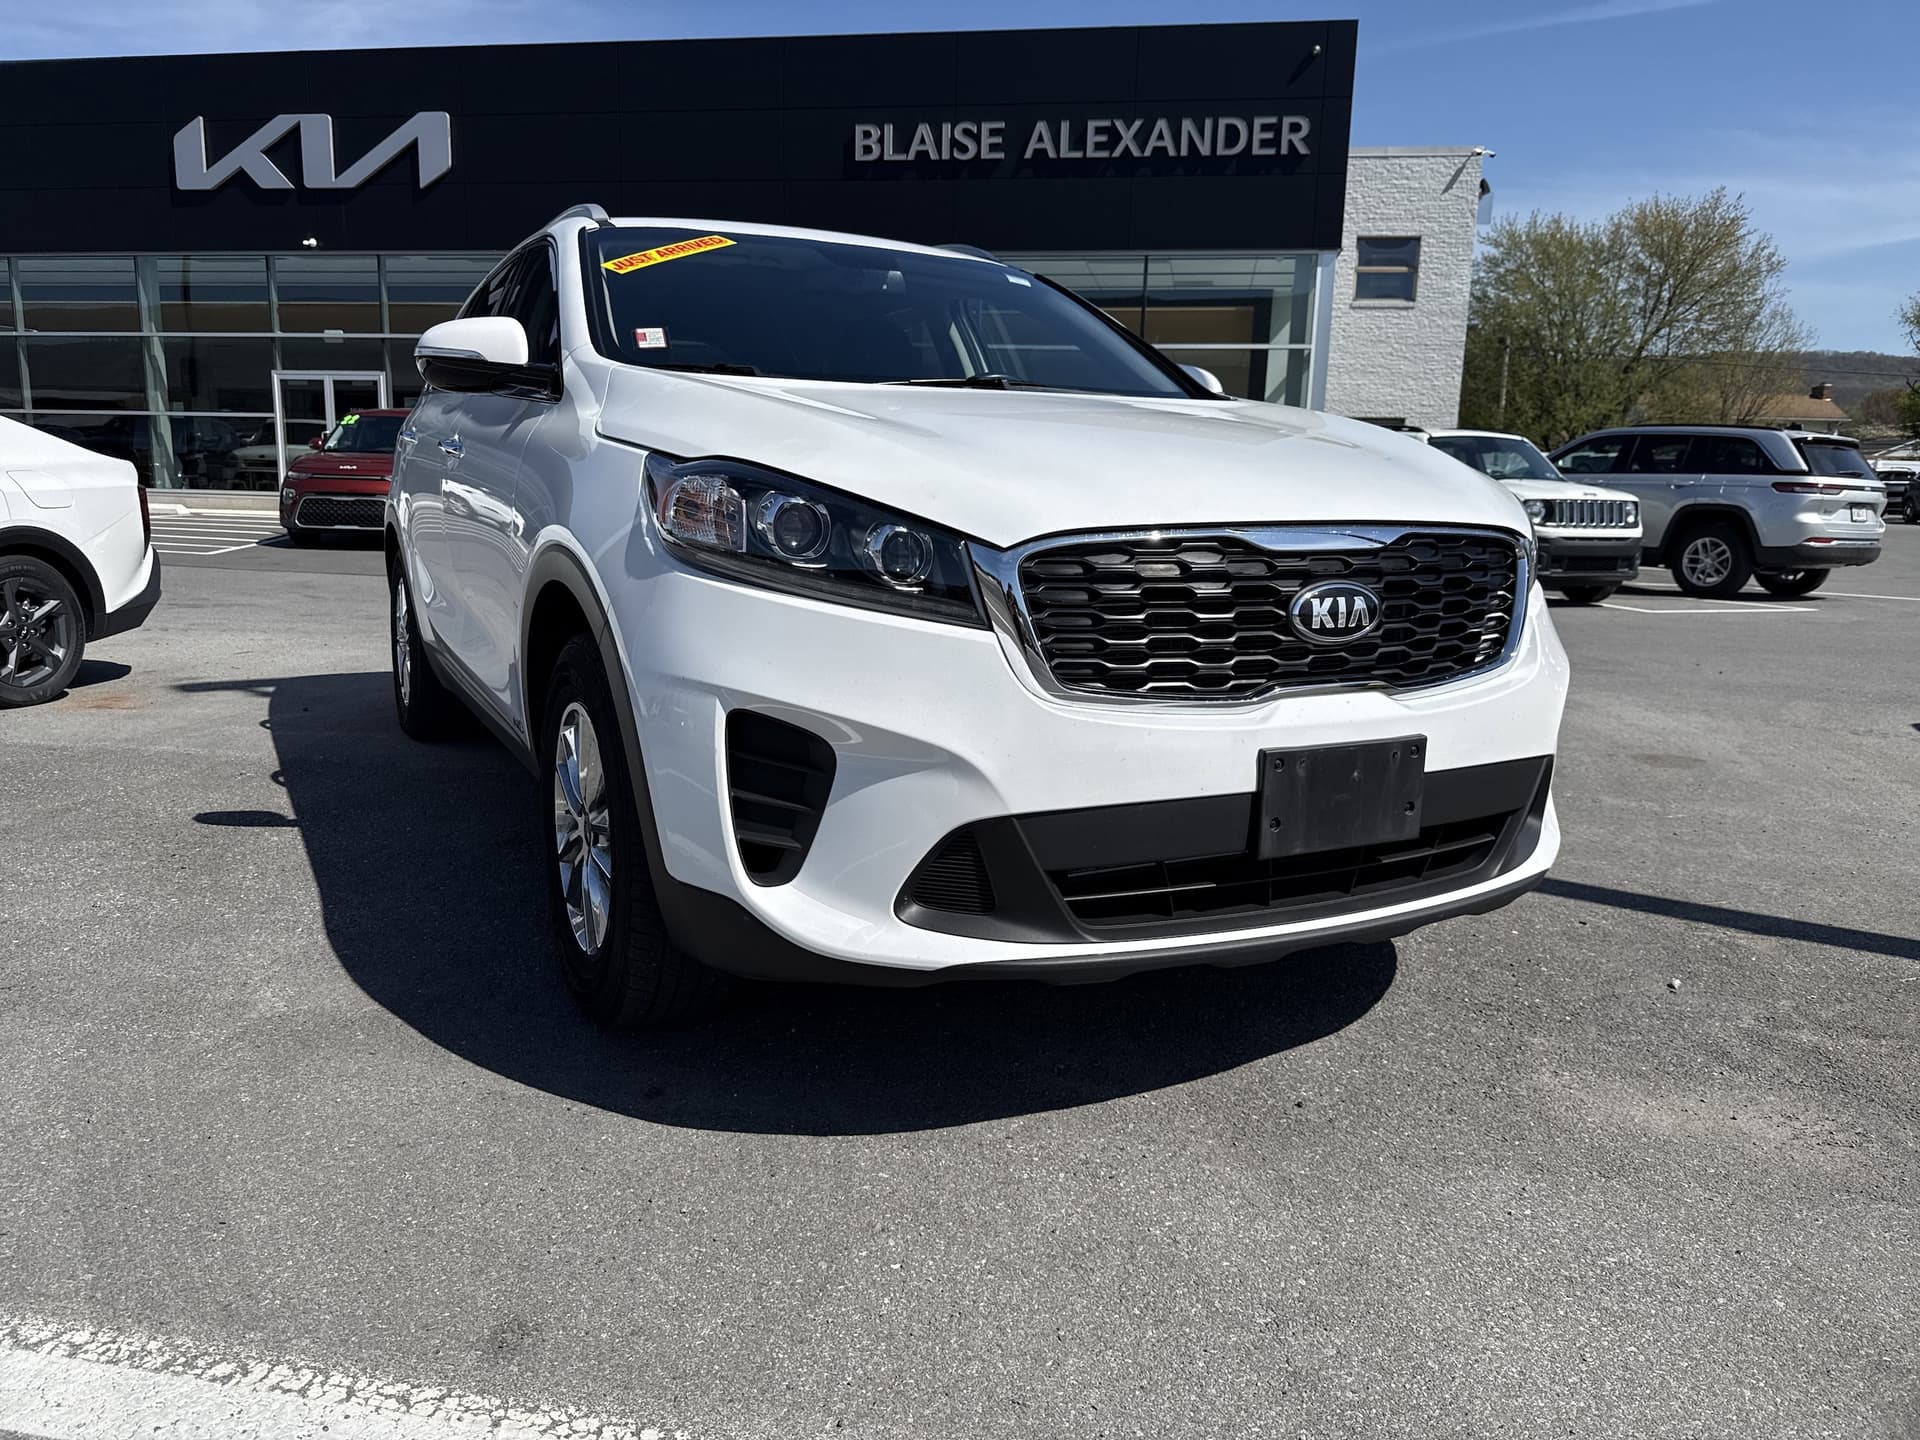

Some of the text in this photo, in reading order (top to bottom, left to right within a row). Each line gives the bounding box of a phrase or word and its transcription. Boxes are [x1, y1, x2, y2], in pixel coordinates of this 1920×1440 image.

[173, 111, 453, 191] KIA
[854, 115, 1312, 162] BLAISE ALEXANDER
[613, 237, 725, 270] JUST ARRIVED
[1310, 596, 1370, 629] KIA
